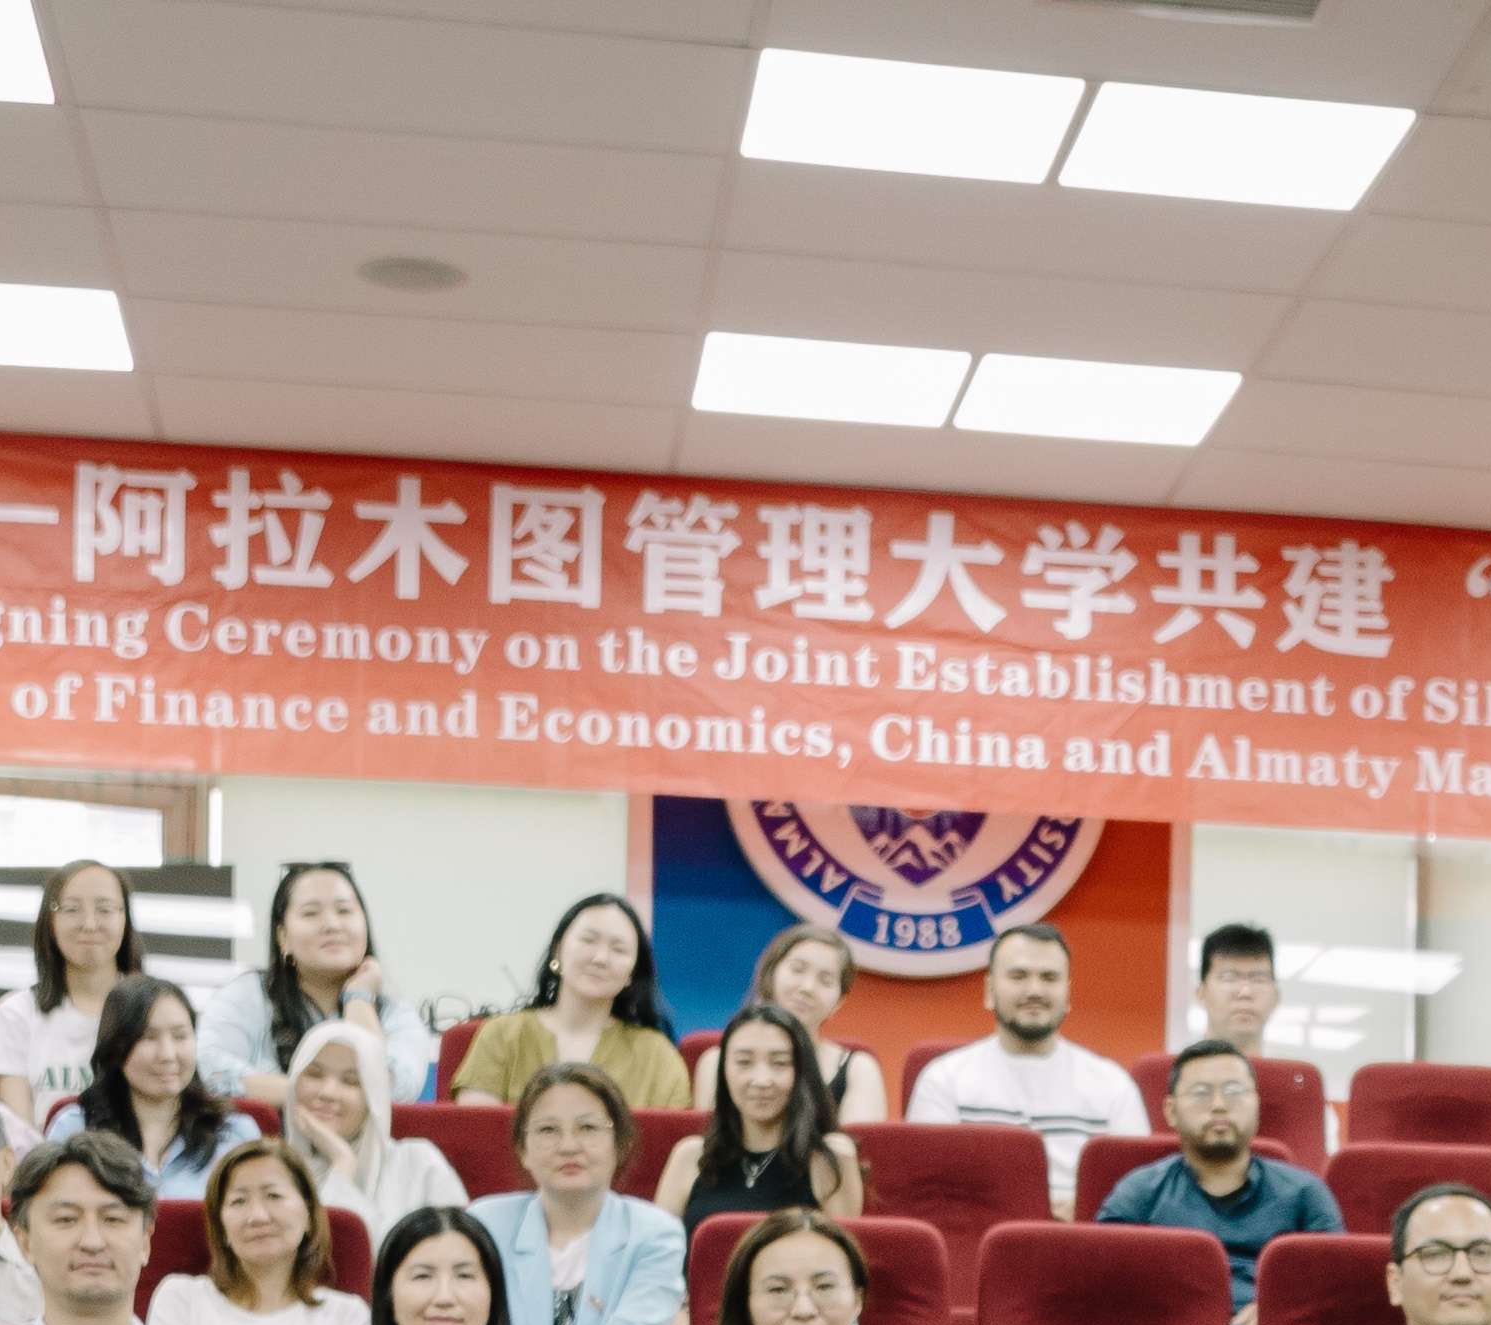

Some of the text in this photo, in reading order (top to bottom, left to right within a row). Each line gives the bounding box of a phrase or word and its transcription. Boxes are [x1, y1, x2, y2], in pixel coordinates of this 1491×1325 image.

[164, 604, 489, 674] Ceremony
[504, 634, 580, 671] on
[597, 627, 698, 678] the
[713, 632, 879, 688] Joint
[894, 641, 1335, 716] Establishment
[1349, 676, 1416, 720] of
[10, 672, 83, 720] of
[94, 672, 349, 734] Finance
[365, 689, 479, 738] and
[497, 692, 853, 768] Economics,
[867, 714, 1050, 772] China
[1062, 730, 1172, 777] and
[1185, 734, 1401, 799] Almaty
[996, 817, 1073, 902] SITY
[874, 913, 962, 949] 1988
